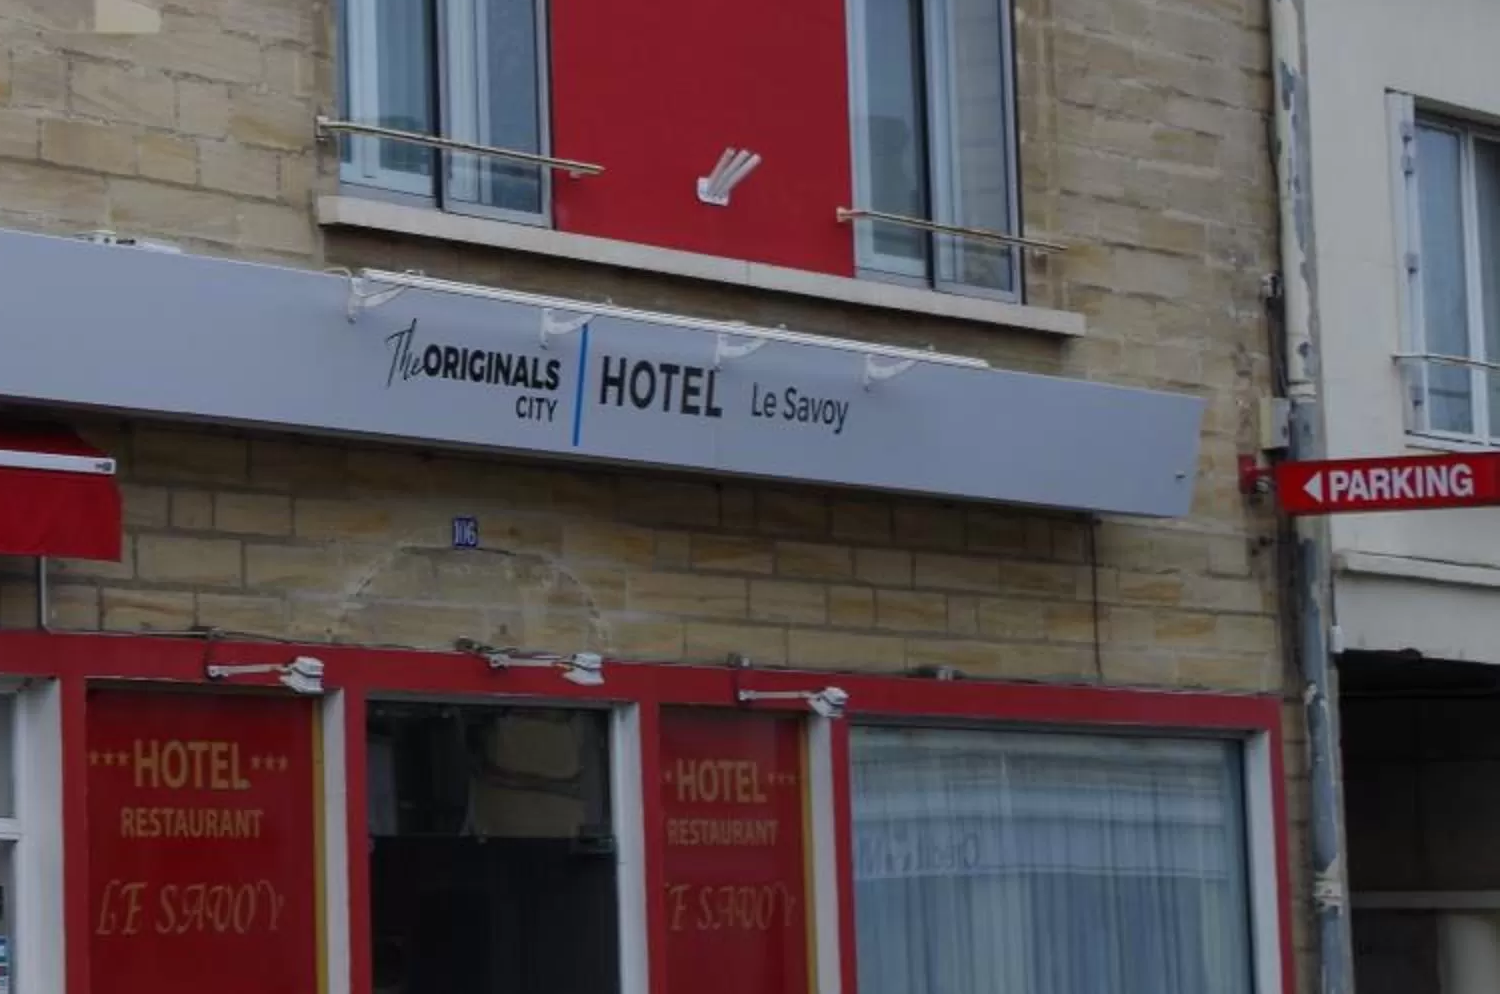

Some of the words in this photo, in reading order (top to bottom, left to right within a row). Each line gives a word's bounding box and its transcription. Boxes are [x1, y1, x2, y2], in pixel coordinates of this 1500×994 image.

[423, 343, 561, 391] ORIGINALS
[600, 355, 723, 418] HOTEL
[751, 382, 777, 418] Le
[782, 386, 849, 435] Savoy
[515, 395, 558, 422] CITY
[1328, 463, 1474, 502] PARKING
[133, 739, 251, 790] HOTEL
[675, 758, 767, 803] HOTEL
[120, 806, 264, 838] RESTAURANT
[667, 818, 779, 846] RESTAURANT
[95, 879, 148, 935] LE
